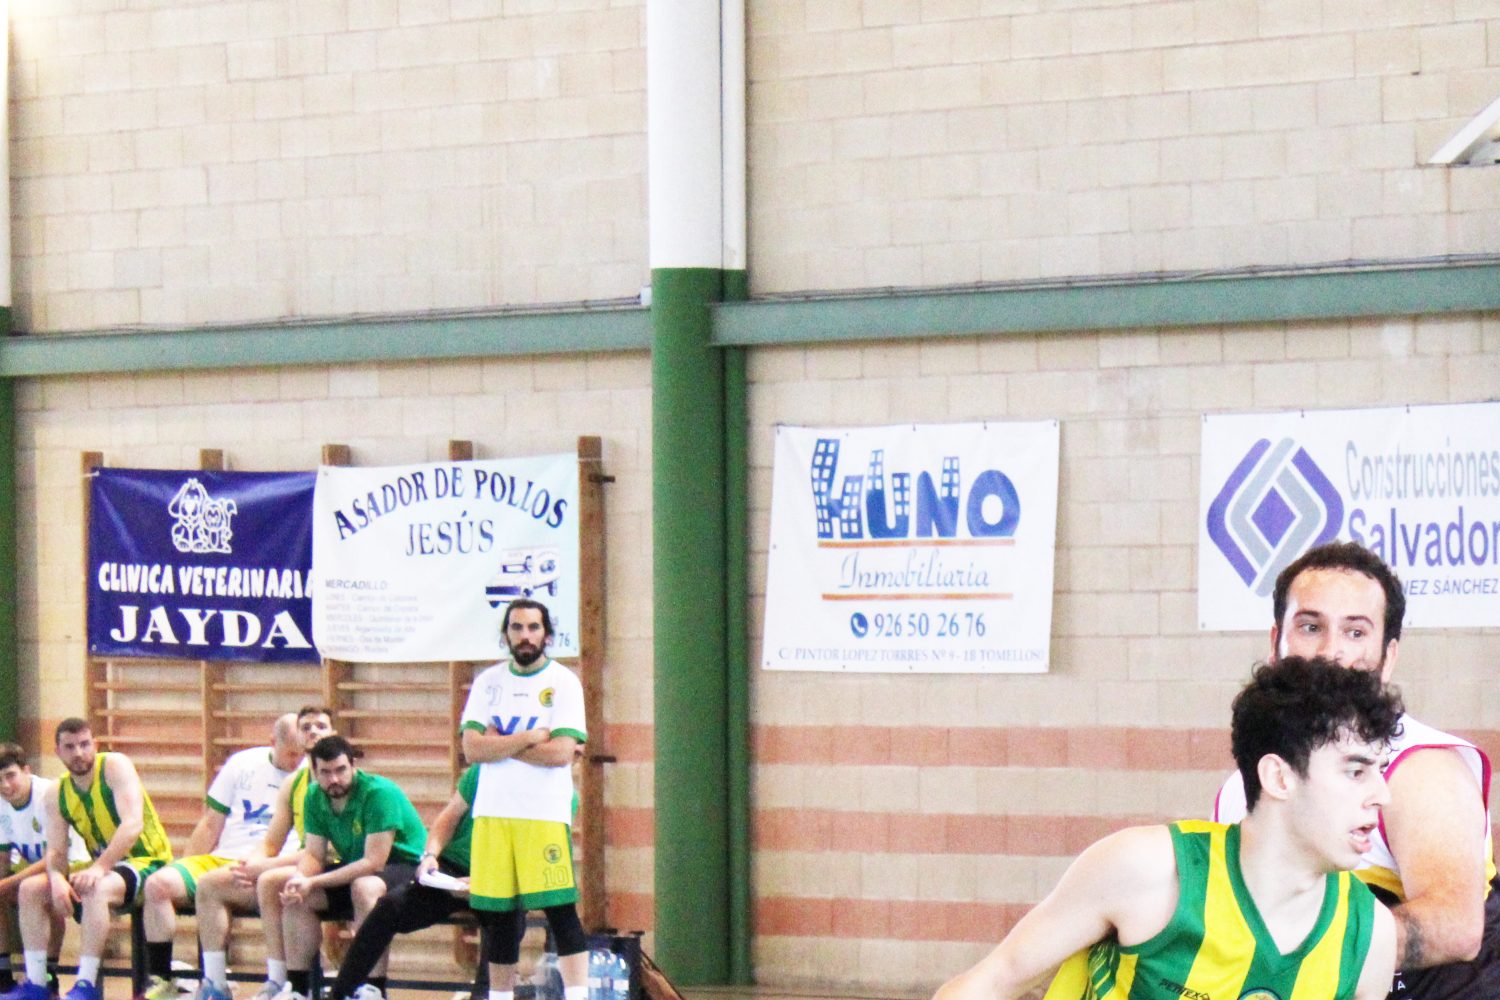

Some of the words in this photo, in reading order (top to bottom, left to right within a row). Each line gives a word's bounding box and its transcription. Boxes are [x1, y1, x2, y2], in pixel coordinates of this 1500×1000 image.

[1346, 435, 1500, 500] Construcciones
[333, 471, 429, 541] ASADOR
[434, 467, 465, 499] DE
[474, 469, 568, 529] POLLOS
[811, 438, 1021, 539] HUNO
[405, 510, 494, 556] JESÚS
[98, 562, 175, 594] CLINICA
[325, 579, 388, 590] MERCADILLO
[838, 548, 990, 589] Inmobiliaria
[1432, 574, 1499, 595] SÁNCHEZ
[110, 605, 313, 648] JAYDA
[874, 613, 902, 637] 926
[907, 612, 930, 637] 50
[937, 612, 960, 637] 26
[965, 612, 986, 637] 76
[795, 648, 839, 661] PINTOR
